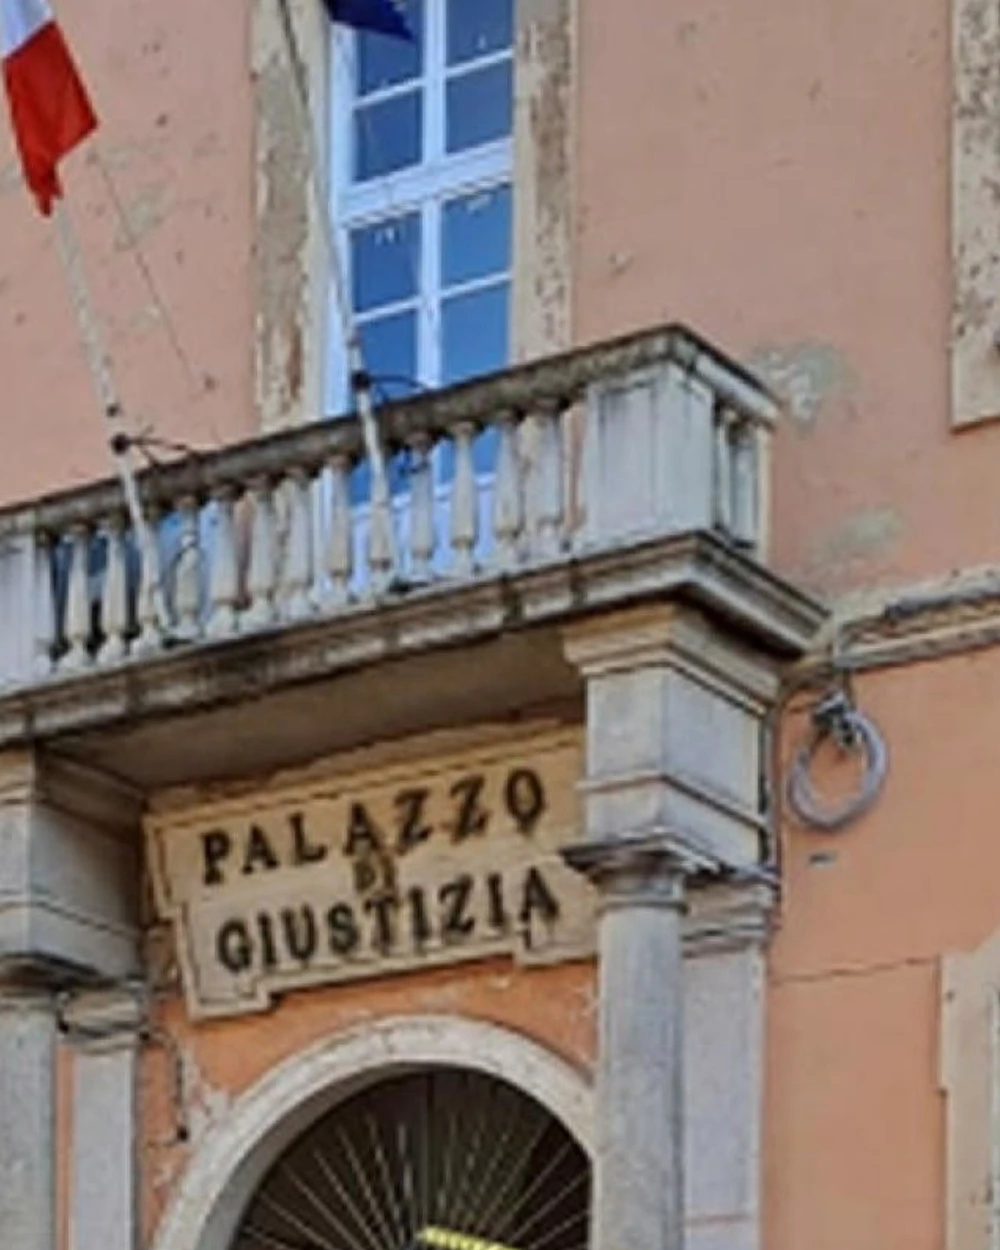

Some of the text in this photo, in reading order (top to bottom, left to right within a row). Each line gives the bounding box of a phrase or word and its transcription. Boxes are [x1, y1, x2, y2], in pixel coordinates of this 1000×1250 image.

[201, 768, 546, 885] PALAZZO
[355, 855, 394, 892] DI
[216, 867, 560, 974] GIUSTIZIA
